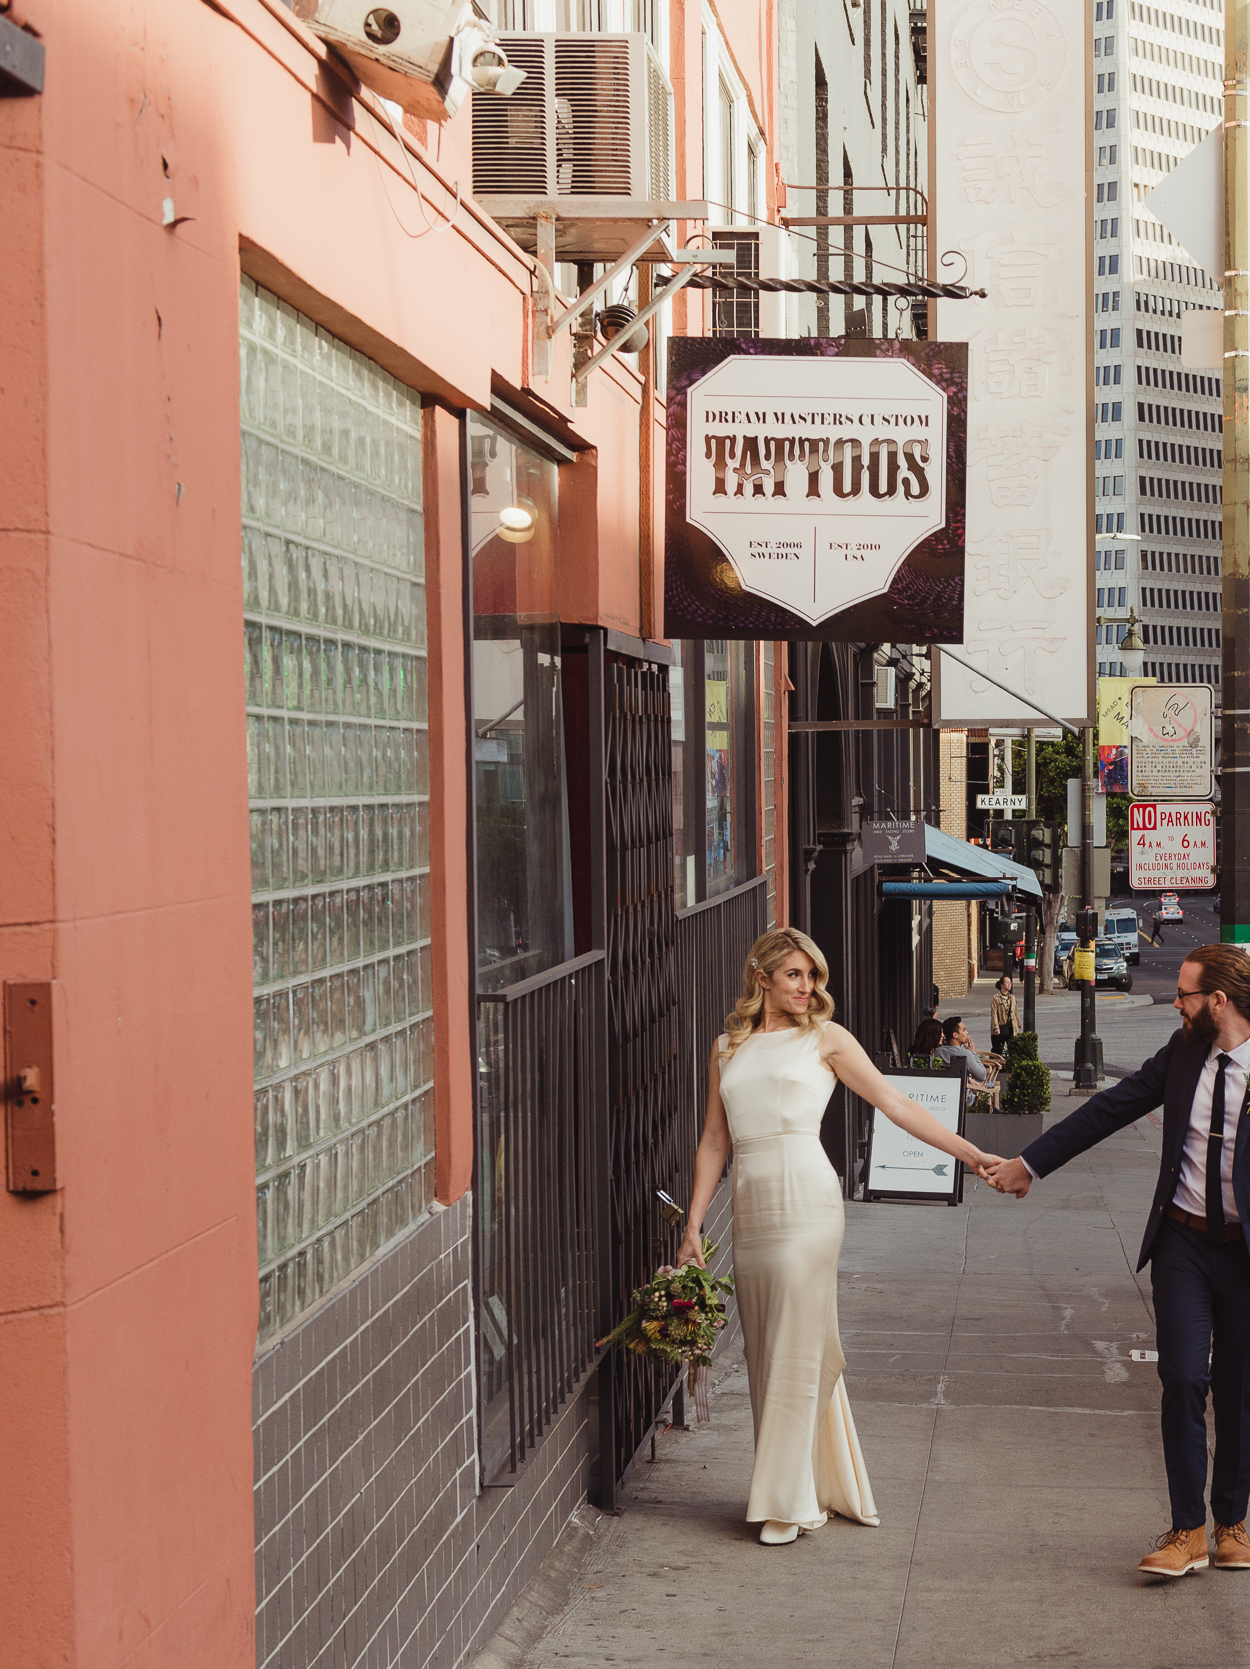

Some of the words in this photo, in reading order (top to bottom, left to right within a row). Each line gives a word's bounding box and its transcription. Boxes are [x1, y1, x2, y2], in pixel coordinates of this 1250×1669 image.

[705, 410, 767, 424] DREAM
[772, 412, 854, 426] MASTERS
[858, 413, 930, 428] CUSTOM
[704, 434, 932, 500] TATTOOS
[749, 541, 773, 549] EST.
[776, 541, 802, 549] 2006
[829, 542, 853, 550] EST.
[750, 552, 800, 560] SWEDEN
[980, 797, 1024, 806] KEARNY
[1133, 807, 1155, 829] NO
[1160, 811, 1211, 827] PARKING
[872, 821, 915, 829] MARITIME
[1136, 833, 1147, 849] 4
[1181, 833, 1191, 849] 6
[1192, 840, 1209, 849] A.M.
[1154, 853, 1191, 861] EVERYDAY
[1135, 862, 1174, 871] INCLUDING
[1176, 861, 1210, 871] HOLIDAYS
[1137, 876, 1167, 886] STREET
[1169, 875, 1209, 885] CLEANING
[908, 1093, 947, 1103] RITIME
